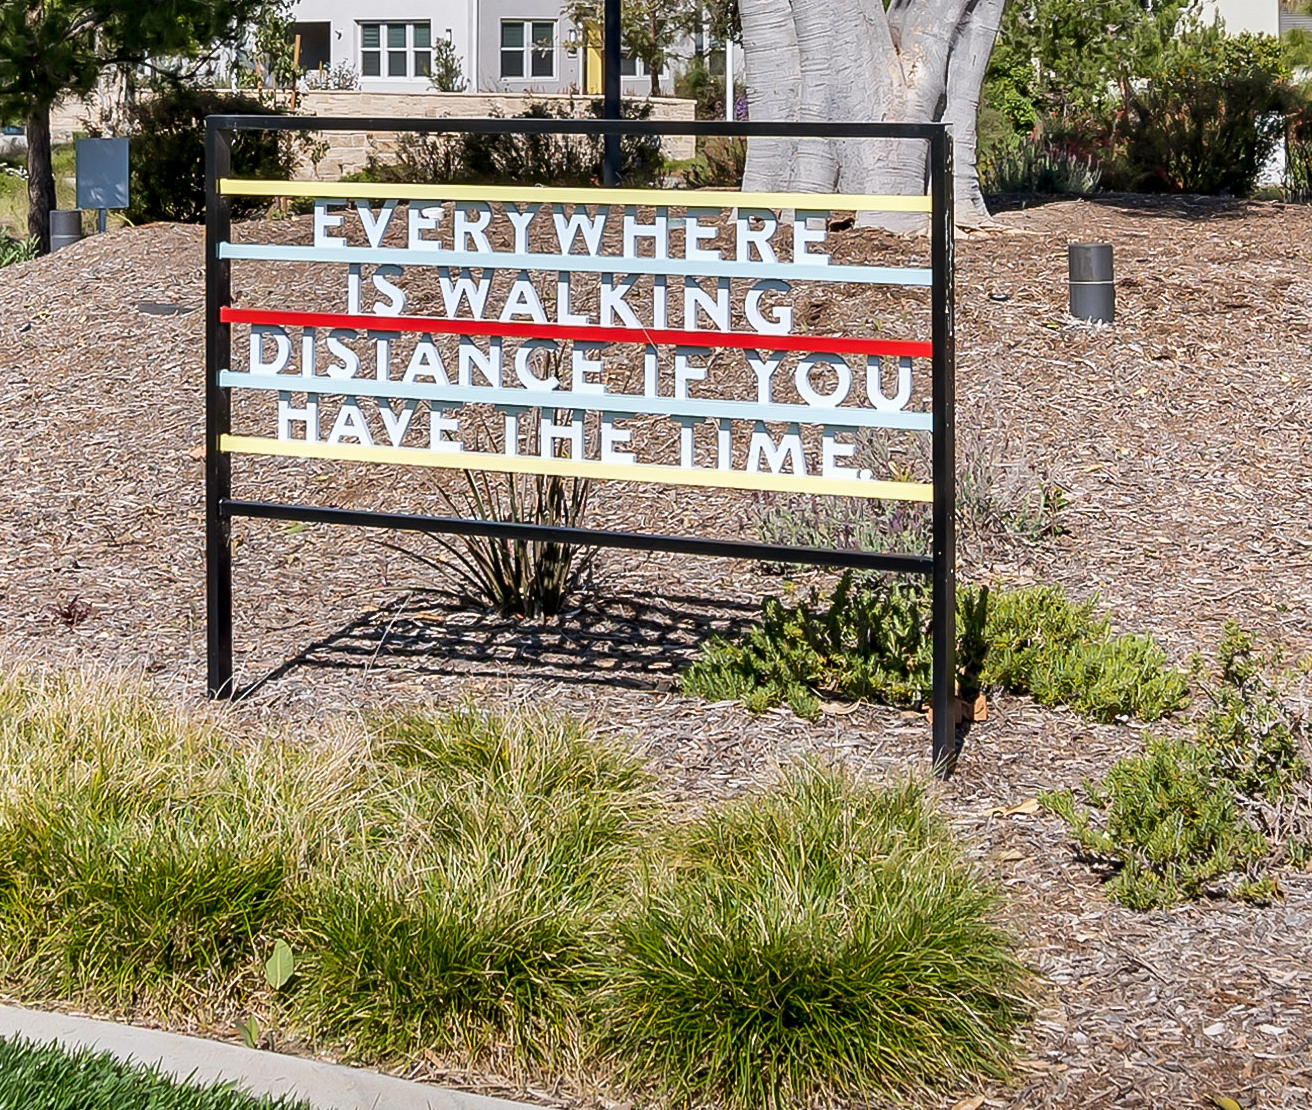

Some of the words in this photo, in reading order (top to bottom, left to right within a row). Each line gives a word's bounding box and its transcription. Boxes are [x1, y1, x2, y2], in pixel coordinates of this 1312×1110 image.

[313, 196, 830, 266] EVERYWHERE
[347, 263, 406, 317] IS
[438, 266, 794, 336] WALKING
[249, 323, 607, 394] DISTANCE
[644, 344, 711, 399] IF
[744, 349, 912, 411] YOU
[277, 389, 464, 451] HAVE
[494, 402, 637, 464] THE
[670, 414, 874, 481] TIME.
